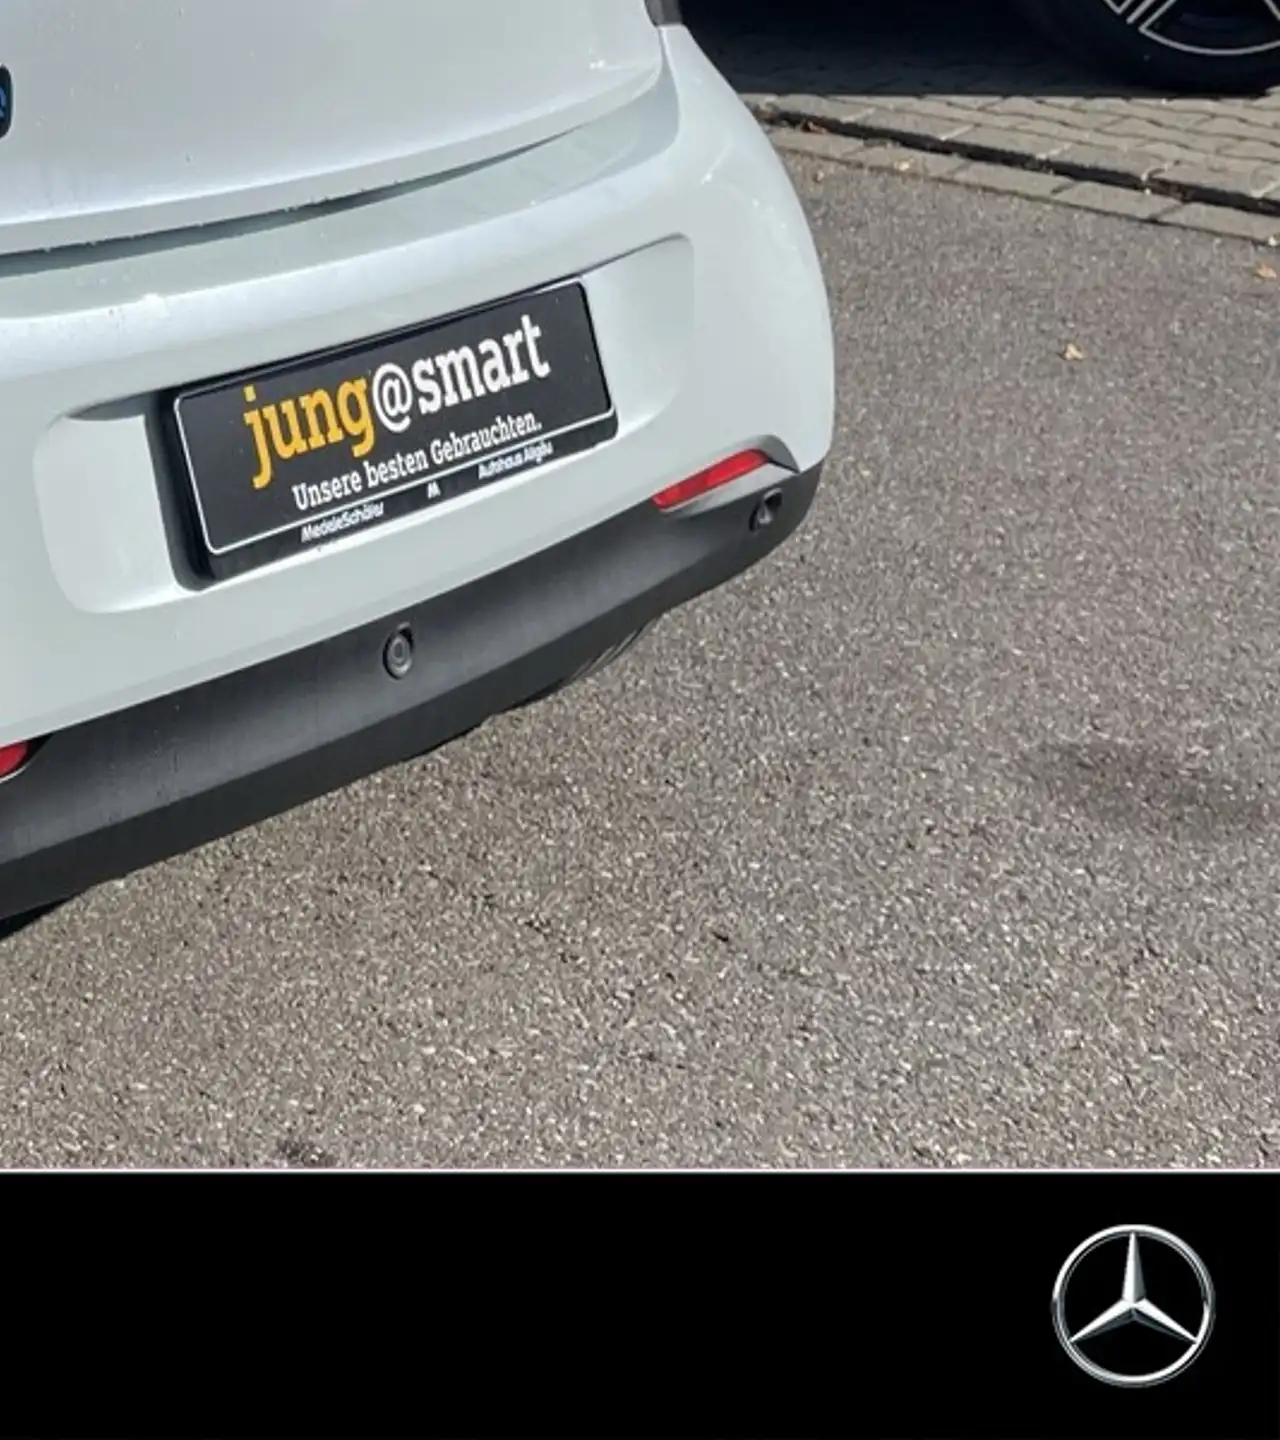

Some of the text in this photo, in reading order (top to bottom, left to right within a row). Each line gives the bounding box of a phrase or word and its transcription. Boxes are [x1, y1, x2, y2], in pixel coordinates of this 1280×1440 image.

[243, 314, 552, 490] jung@smart
[292, 411, 543, 510] Unsere besten Gebrauchten.
